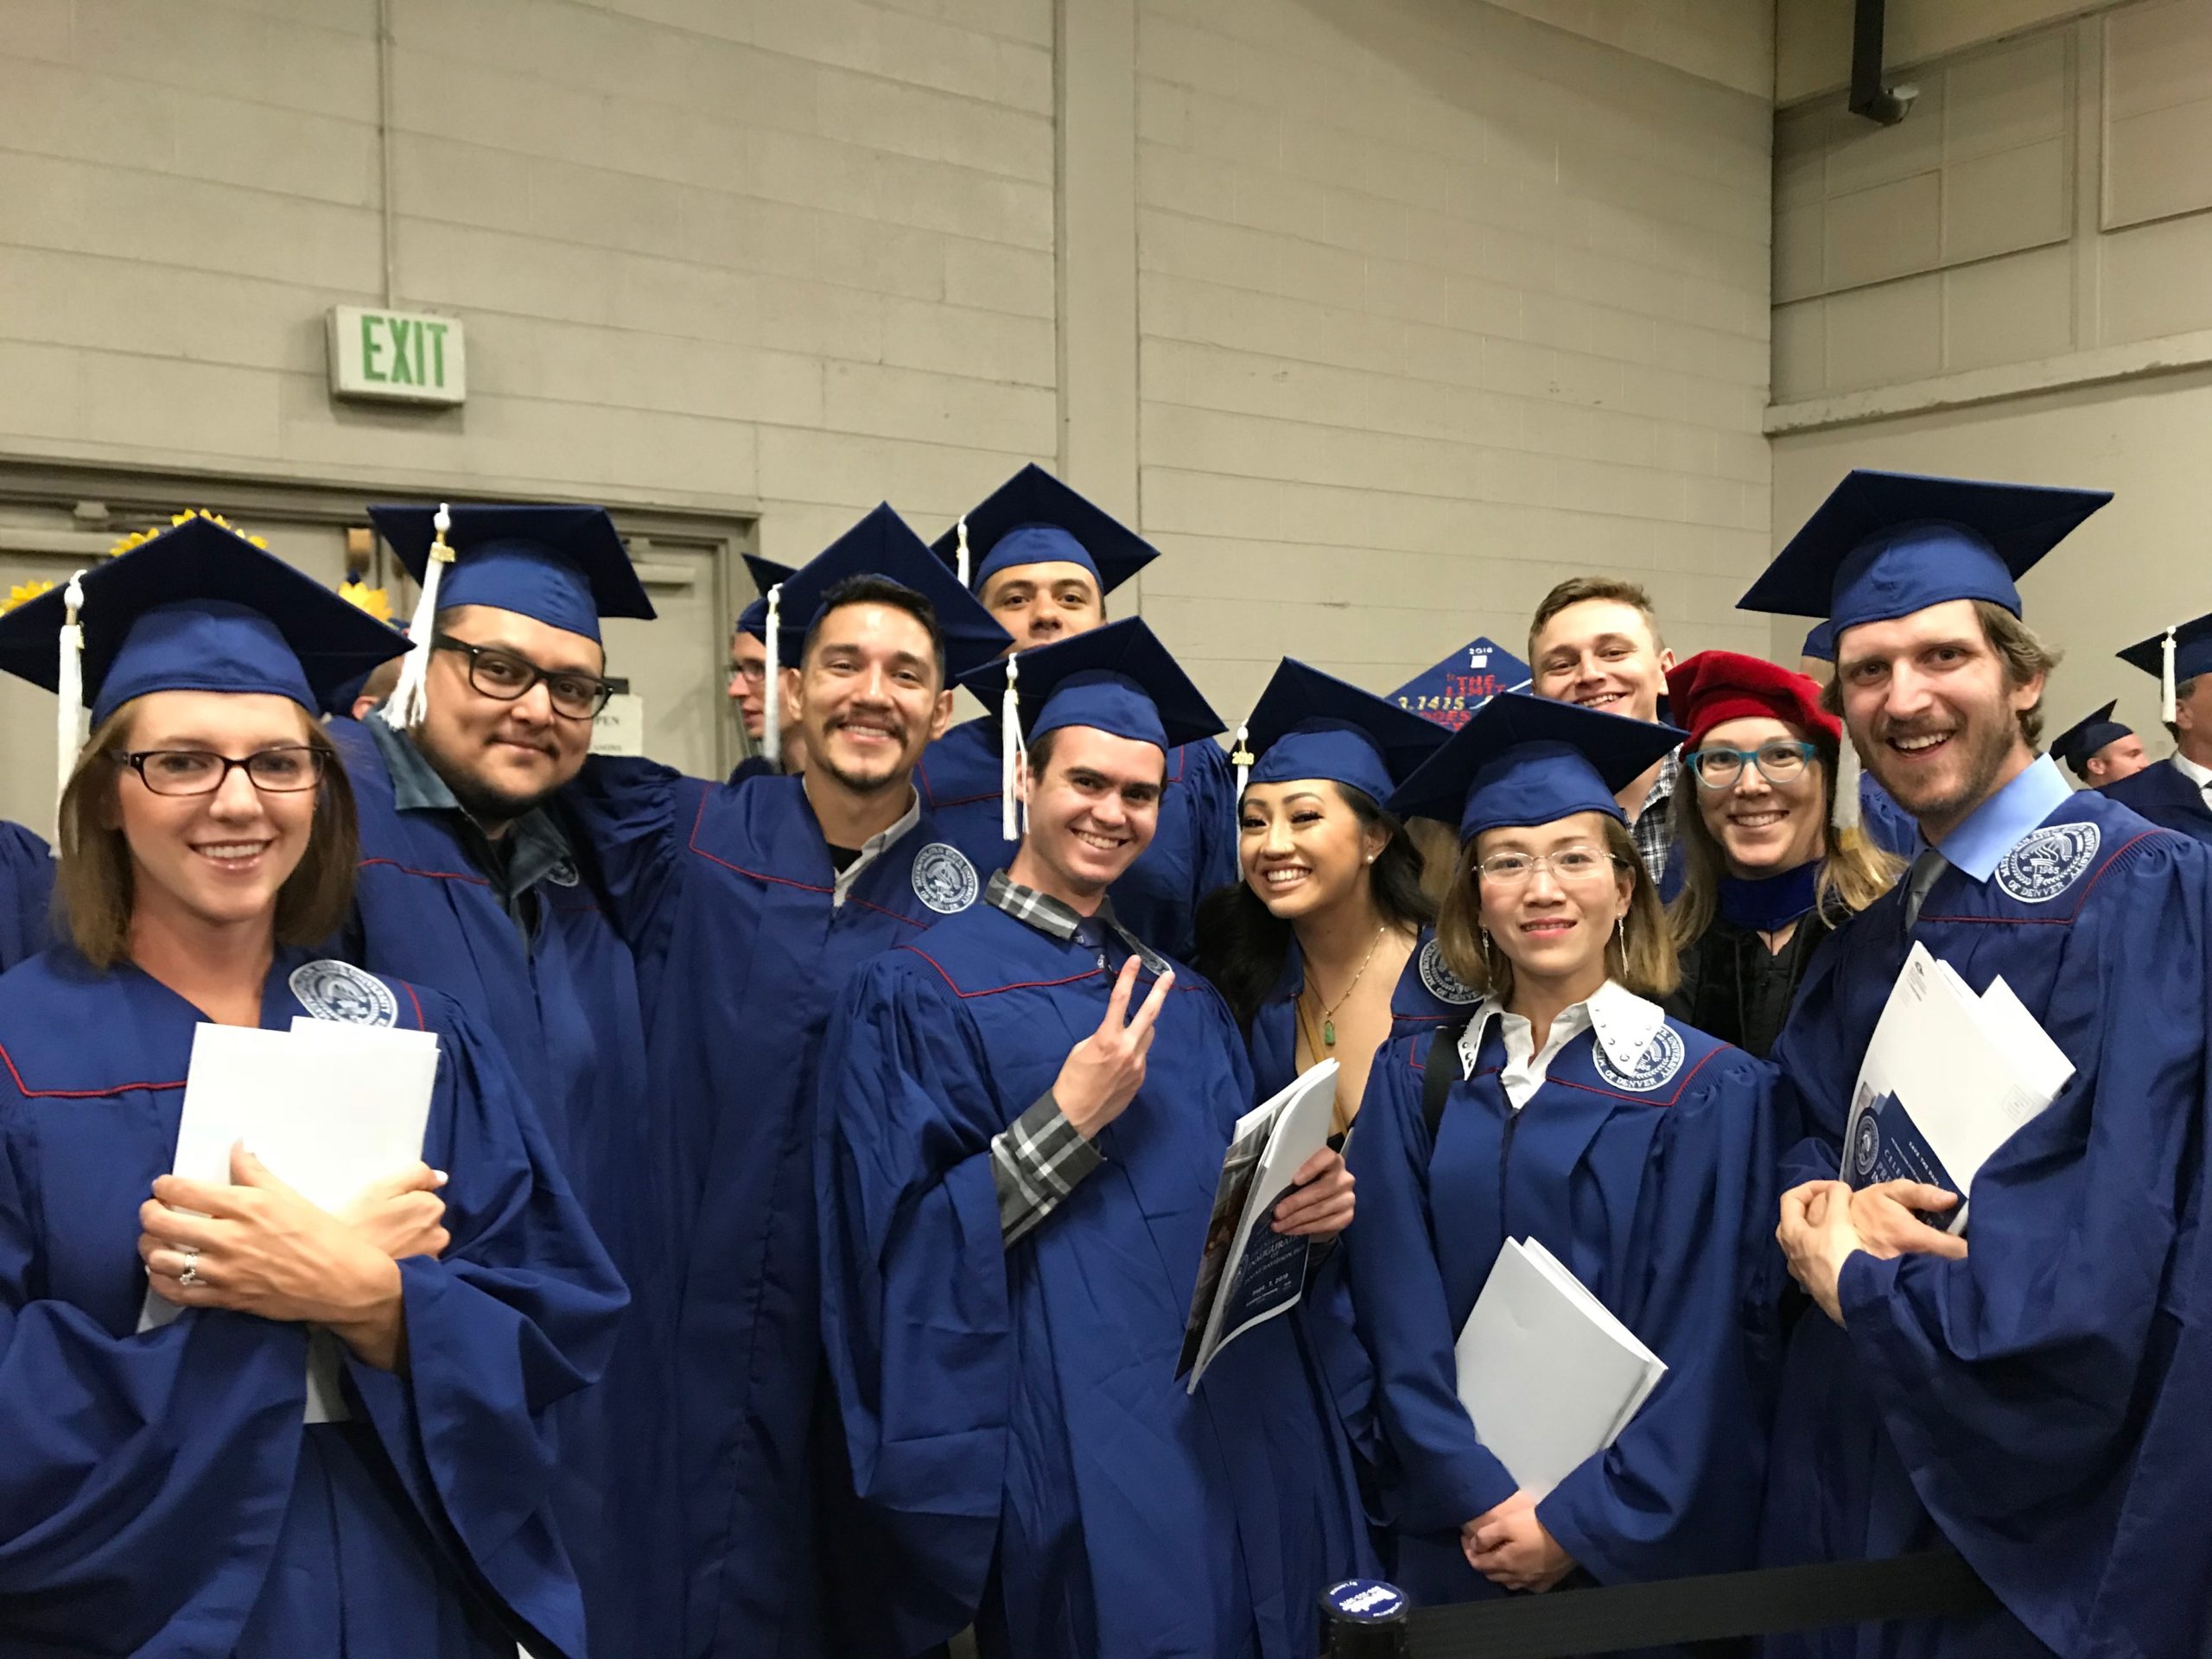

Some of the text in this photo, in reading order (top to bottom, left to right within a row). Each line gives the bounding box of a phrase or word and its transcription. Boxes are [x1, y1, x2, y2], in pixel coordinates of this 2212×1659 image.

[361, 315, 448, 388] EXIT
[594, 715, 620, 725] PEN
[1231, 751, 1255, 766] 2018
[2039, 866, 2060, 874] 1965
[2008, 880, 2064, 898] OF DENVER
[1660, 1035, 1681, 1079] UNIVERSITY
[1605, 1069, 1657, 1089] OF DENVER
